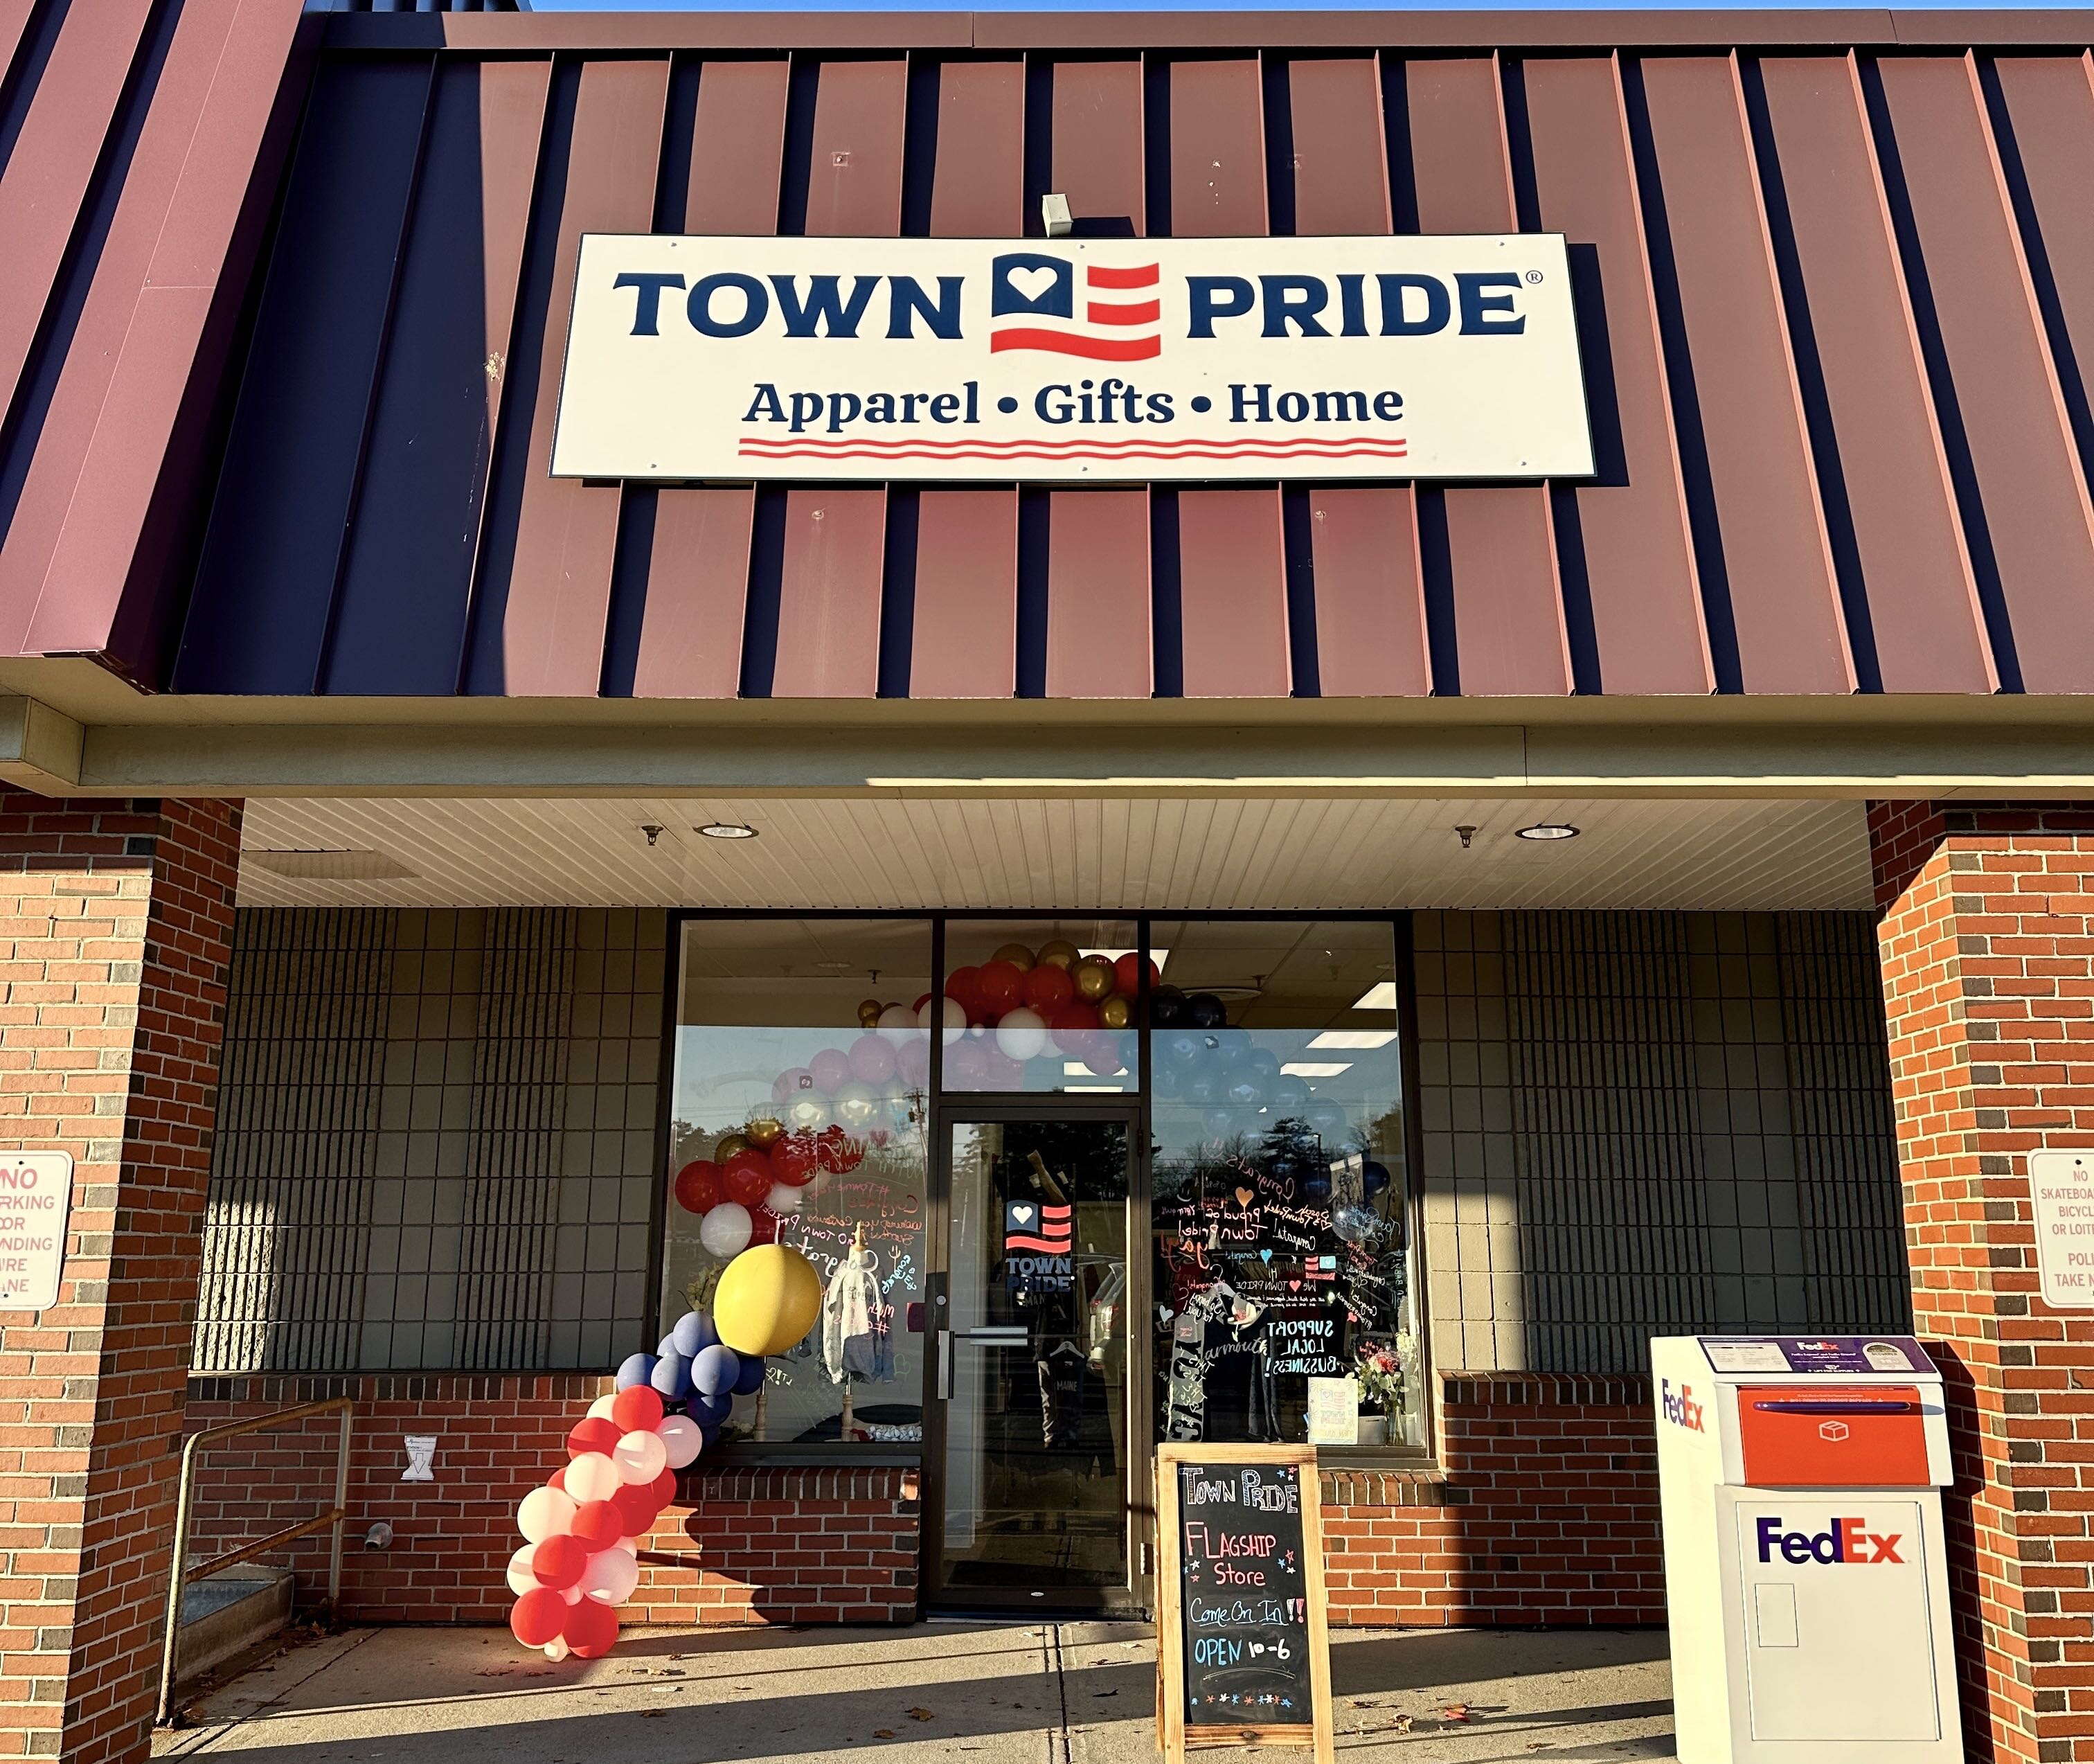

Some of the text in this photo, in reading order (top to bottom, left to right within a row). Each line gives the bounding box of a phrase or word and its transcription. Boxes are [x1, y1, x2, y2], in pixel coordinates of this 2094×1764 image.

[614, 272, 963, 339] TOWN
[741, 378, 1404, 433] Apparel Gifts Home
[2073, 1170, 2088, 1182] NO
[2041, 1188, 2094, 1200] SKATEBOA
[0, 1196, 55, 1210] RKING
[2059, 1206, 2094, 1217] BICYCL
[2052, 1224, 2066, 1235] OR
[0, 1238, 53, 1250] NDING
[0, 1258, 27, 1272] IRE
[1005, 1258, 1071, 1274] TOWN
[1007, 1276, 1071, 1292] PRIDE
[2055, 1274, 2094, 1287] TAKE N
[1203, 1337, 1268, 1360] armouth
[1796, 1341, 1839, 1351] FedEx
[1662, 1378, 1705, 1434] FedEx
[1185, 1522, 1276, 1559] FLAGSHIP
[1756, 1517, 1905, 1565] FedEx
[1213, 1562, 1266, 1587] Store
[1190, 1597, 1231, 1626] Come
[1231, 1600, 1255, 1624] On
[1194, 1638, 1291, 1666] OPEN 10-6
